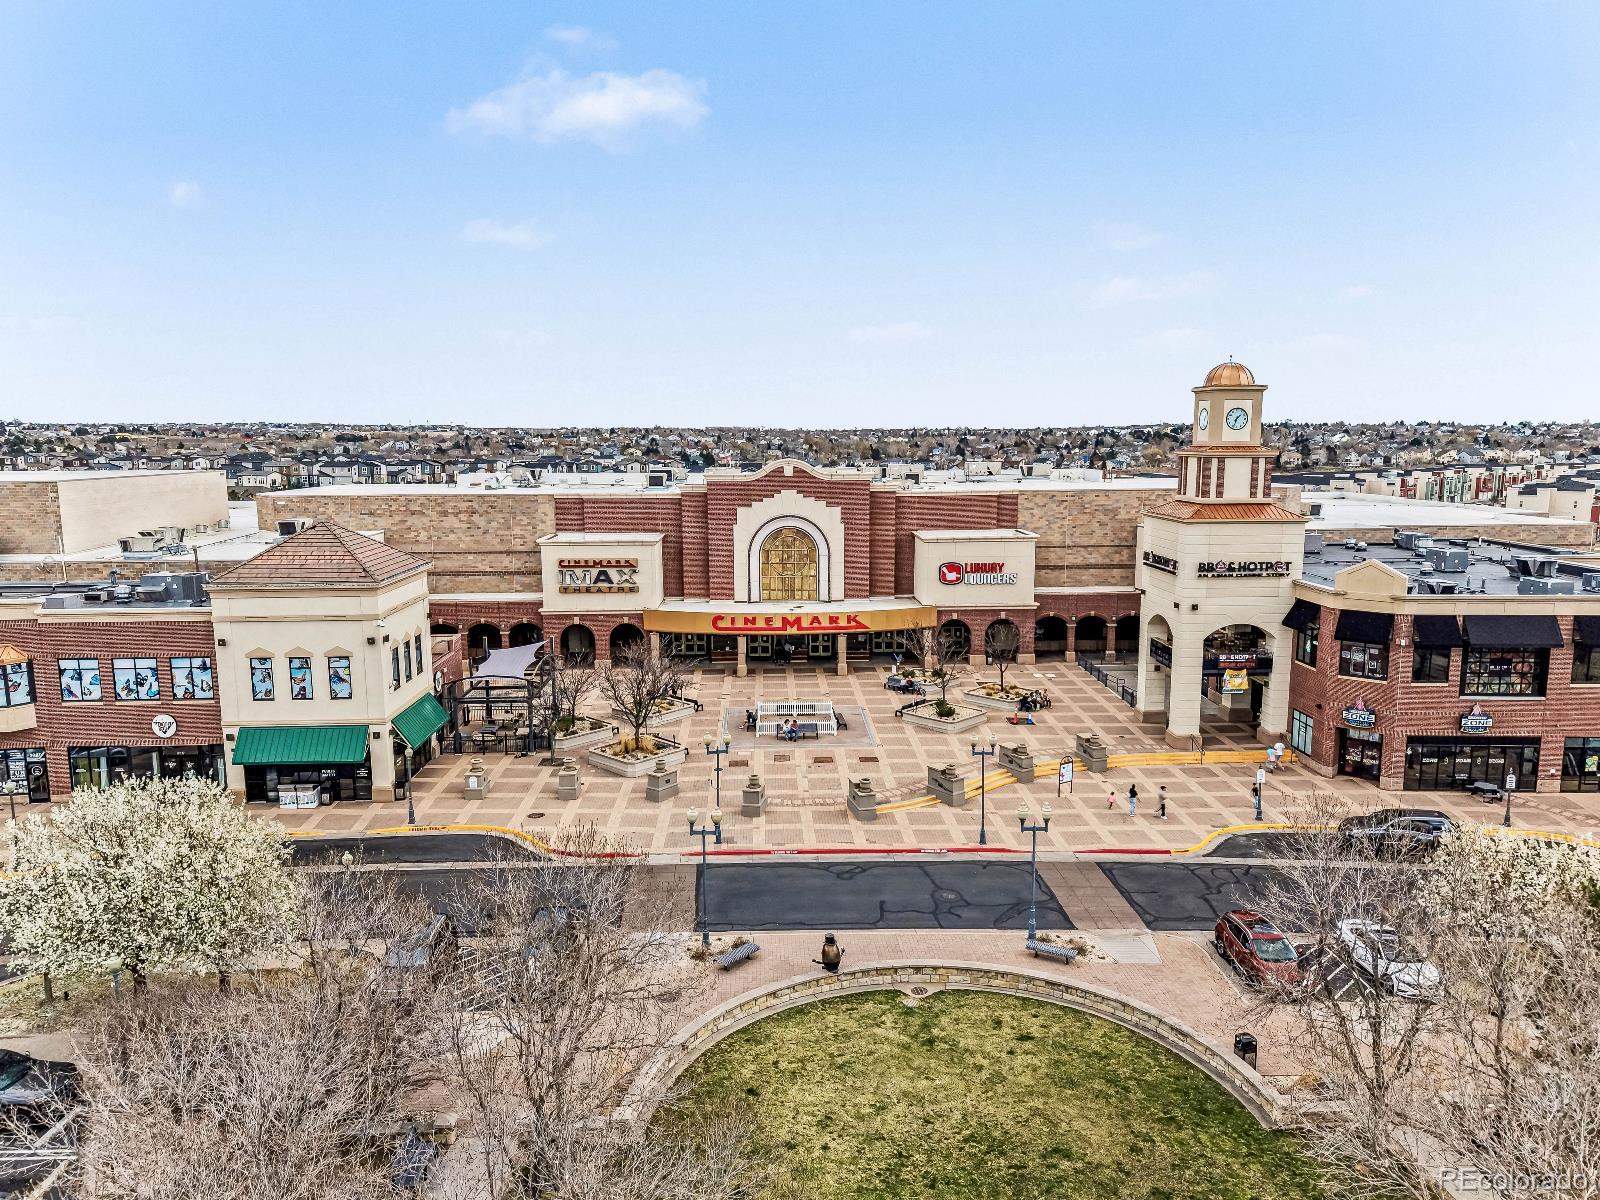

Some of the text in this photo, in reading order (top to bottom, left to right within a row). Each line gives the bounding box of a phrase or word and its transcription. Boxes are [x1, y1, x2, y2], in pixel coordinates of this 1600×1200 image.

[558, 559, 638, 568] CINEMARK
[964, 562, 1005, 573] LUXURY
[558, 569, 640, 585] IMAX
[964, 573, 1018, 584] LOUNGERS
[711, 614, 872, 632] CINEMARK
[1343, 711, 1375, 722] ZONE
